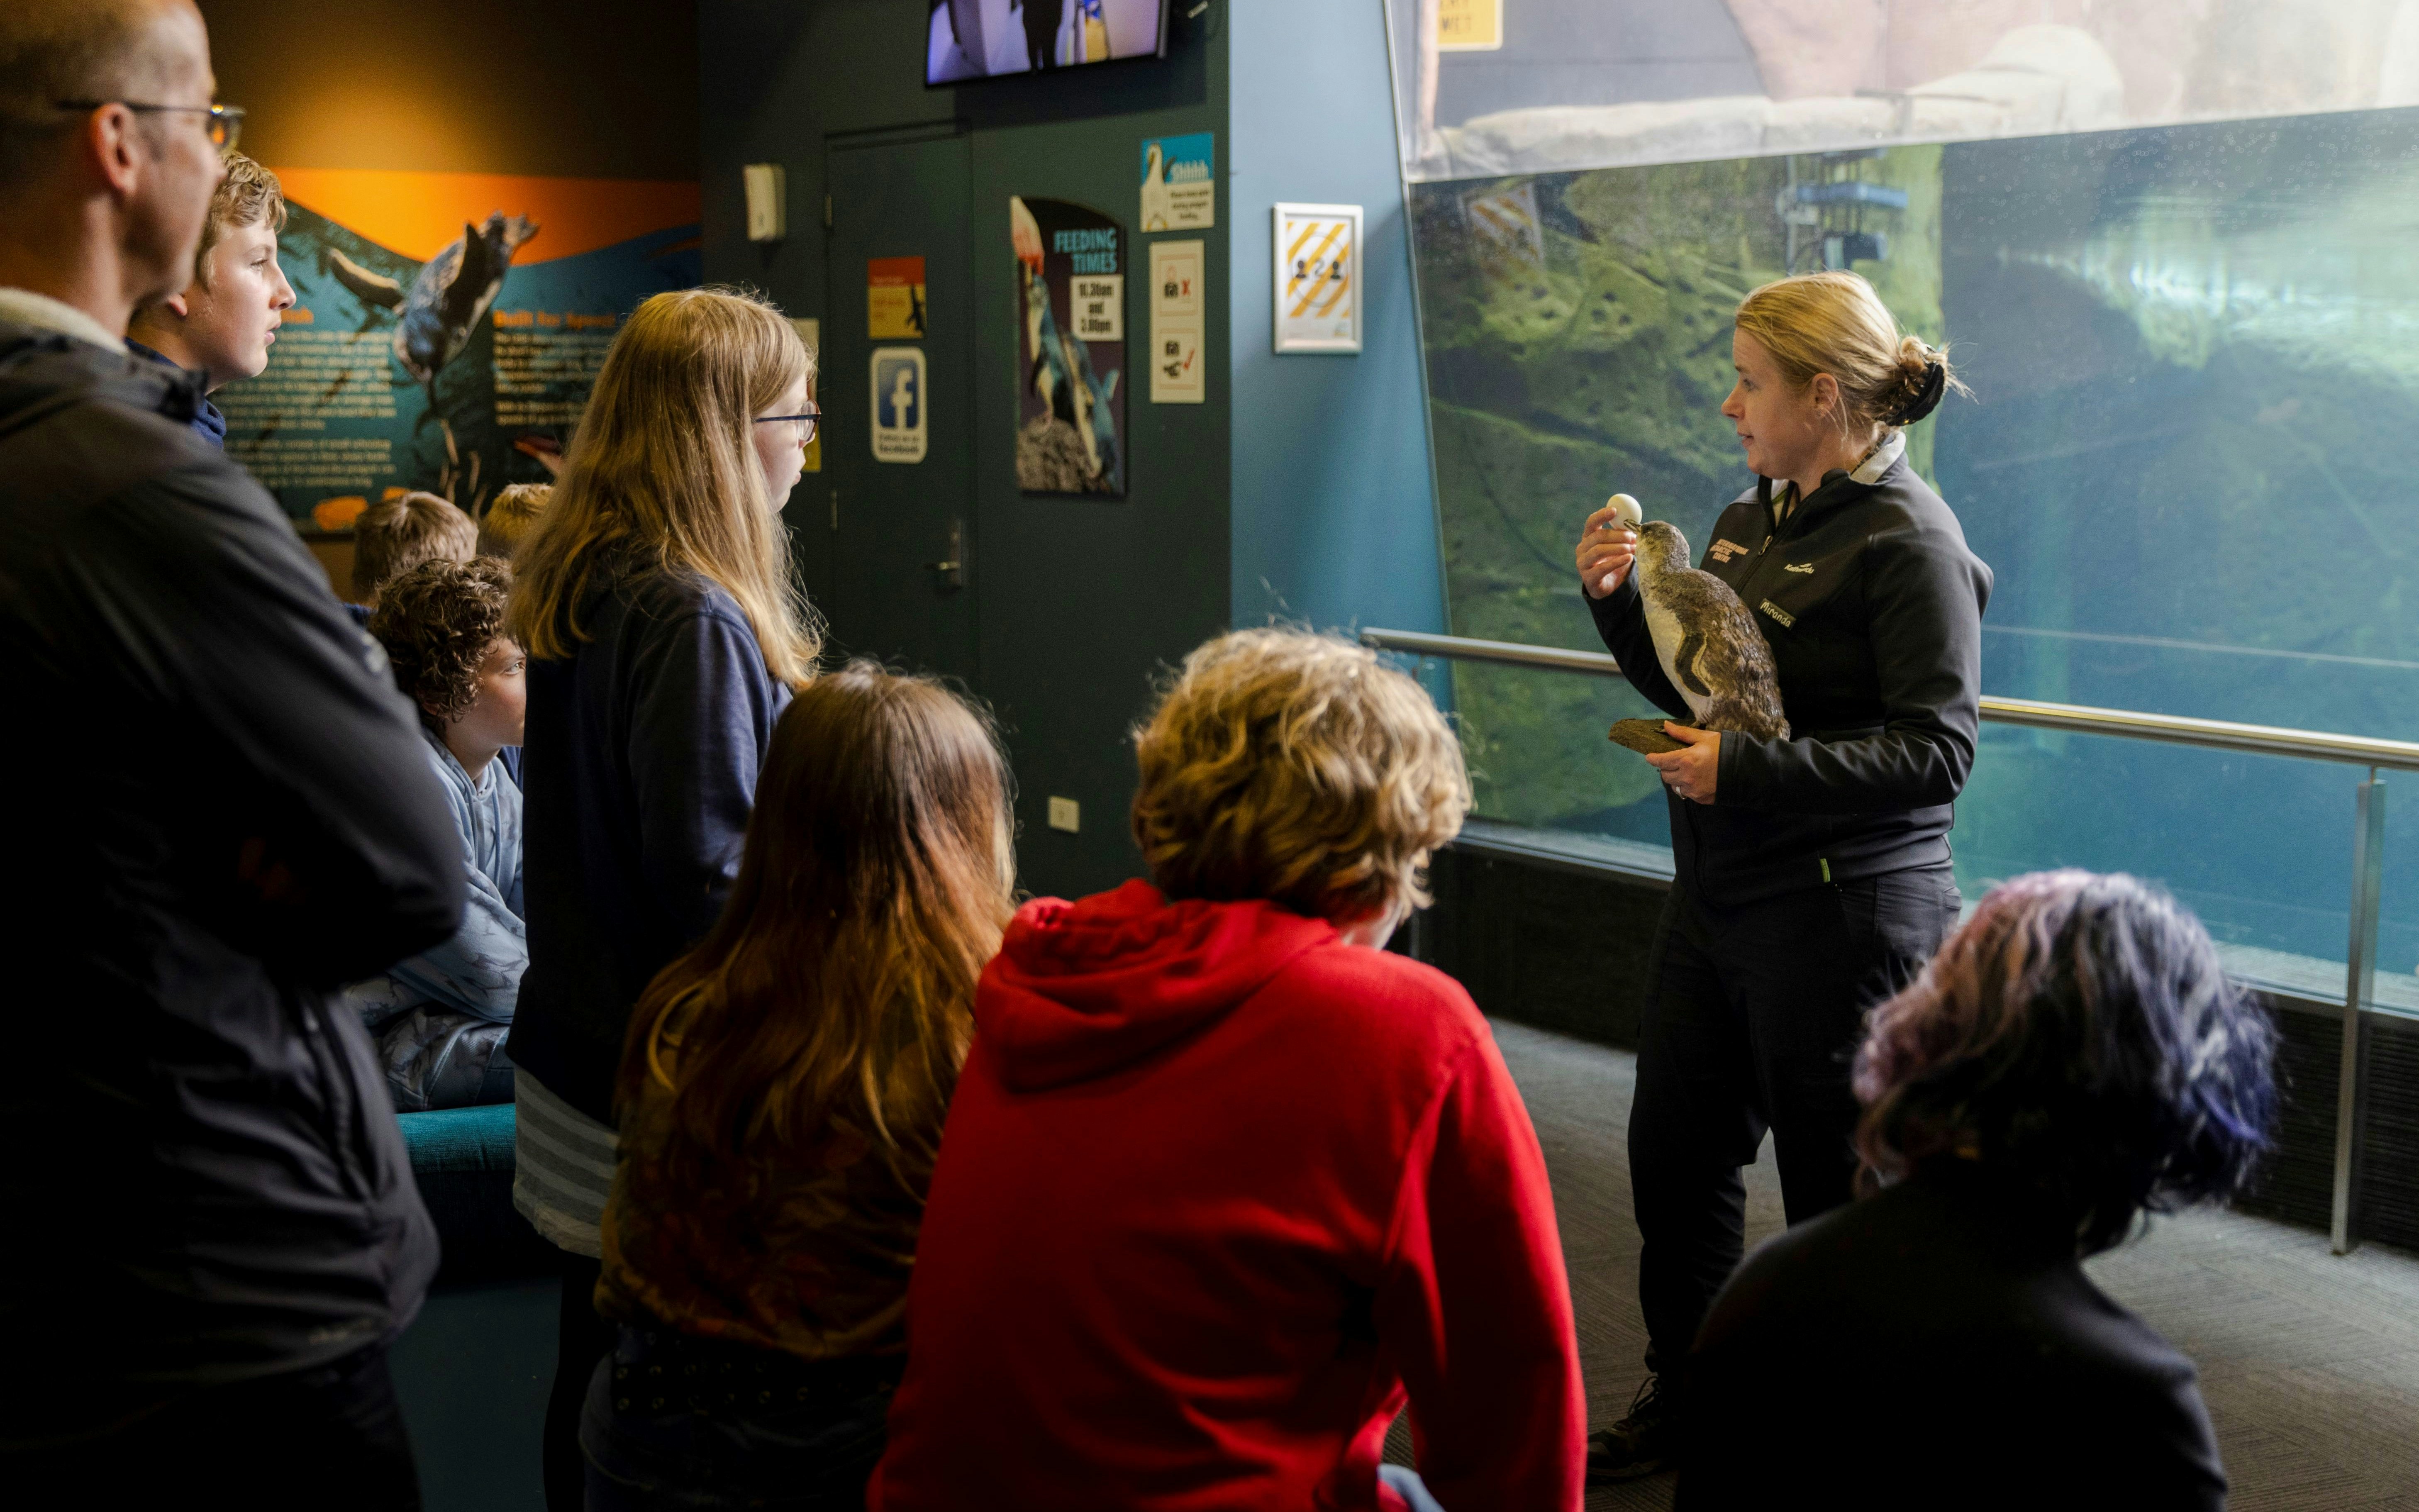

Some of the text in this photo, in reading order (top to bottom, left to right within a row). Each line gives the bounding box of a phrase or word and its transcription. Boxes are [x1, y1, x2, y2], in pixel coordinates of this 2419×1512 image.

[1054, 228, 1117, 253] FEEDING
[1072, 252, 1117, 274] TIMES
[1088, 302, 1103, 314] and
[1760, 601, 1791, 628] Miranda
